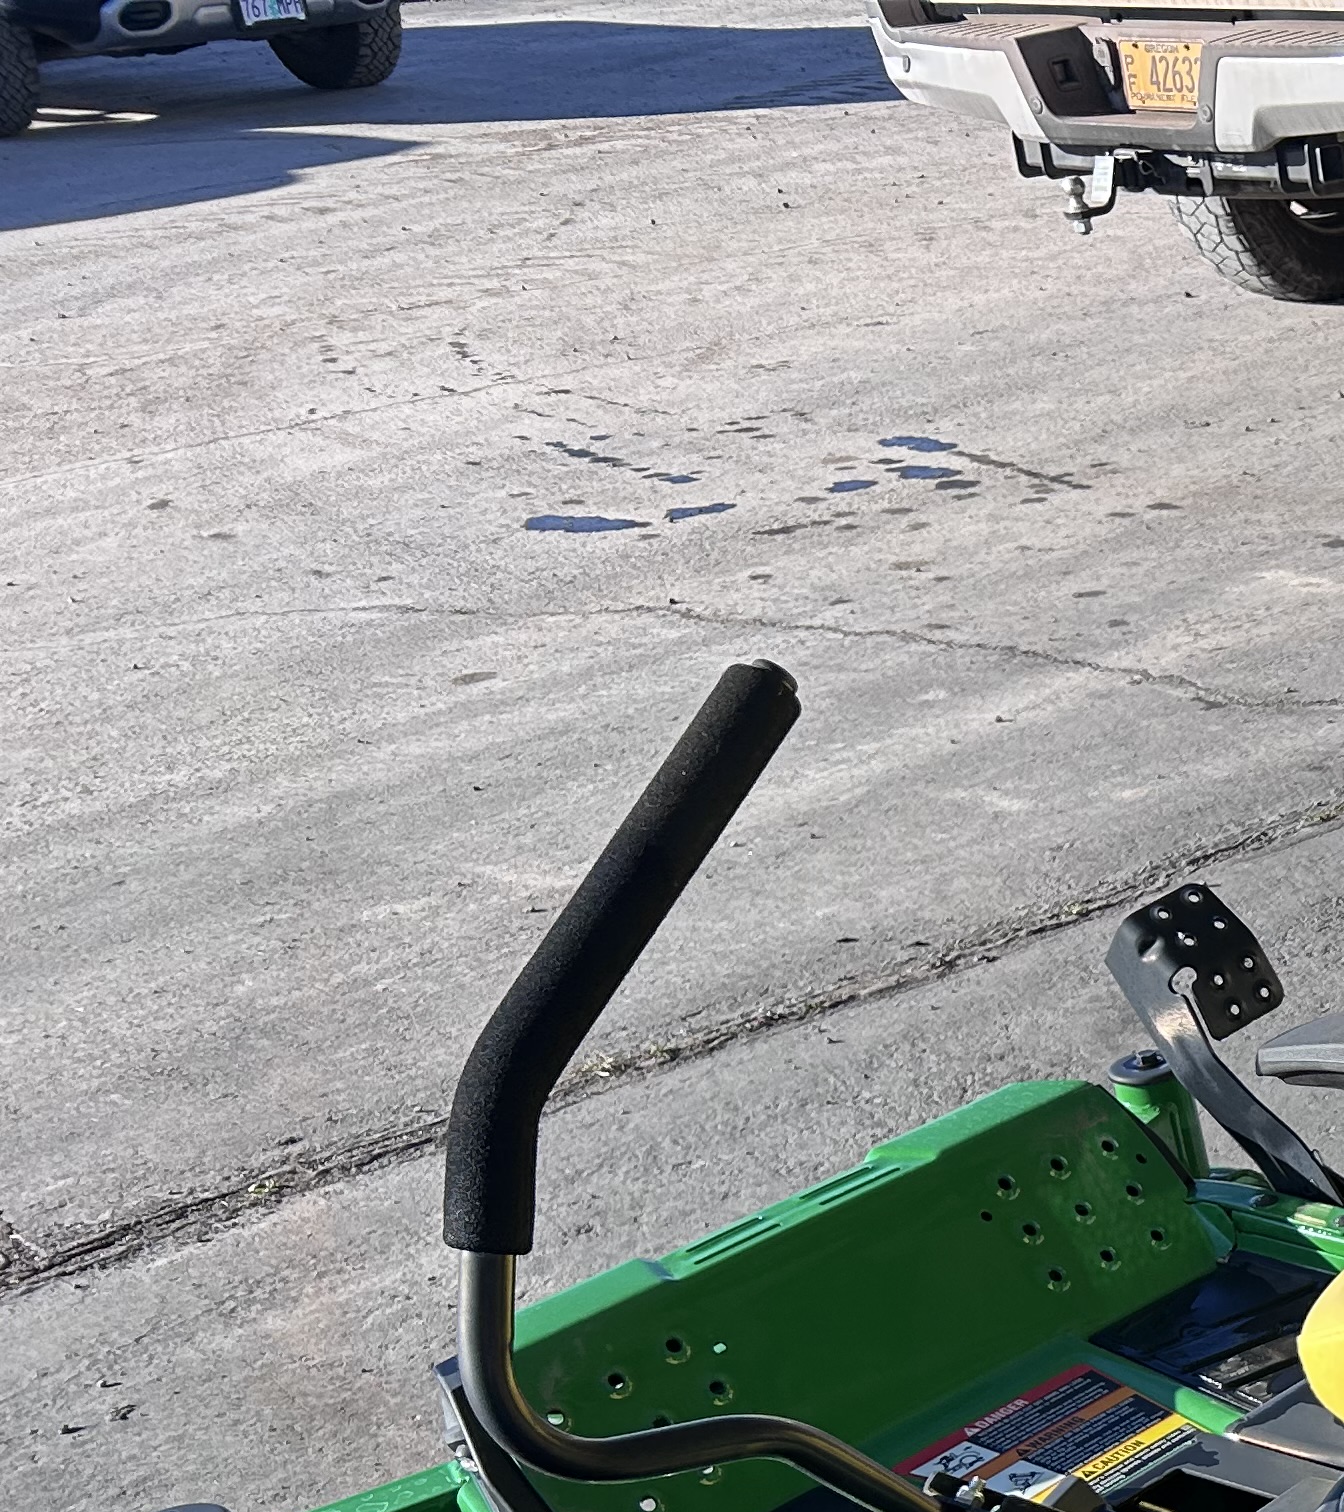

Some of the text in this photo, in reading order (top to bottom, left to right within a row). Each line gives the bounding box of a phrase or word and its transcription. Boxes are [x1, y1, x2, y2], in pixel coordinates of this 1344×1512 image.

[975, 1398, 1030, 1429] DANGER
[1026, 1415, 1086, 1450] WARNING
[1096, 1439, 1145, 1470] CAUTION
